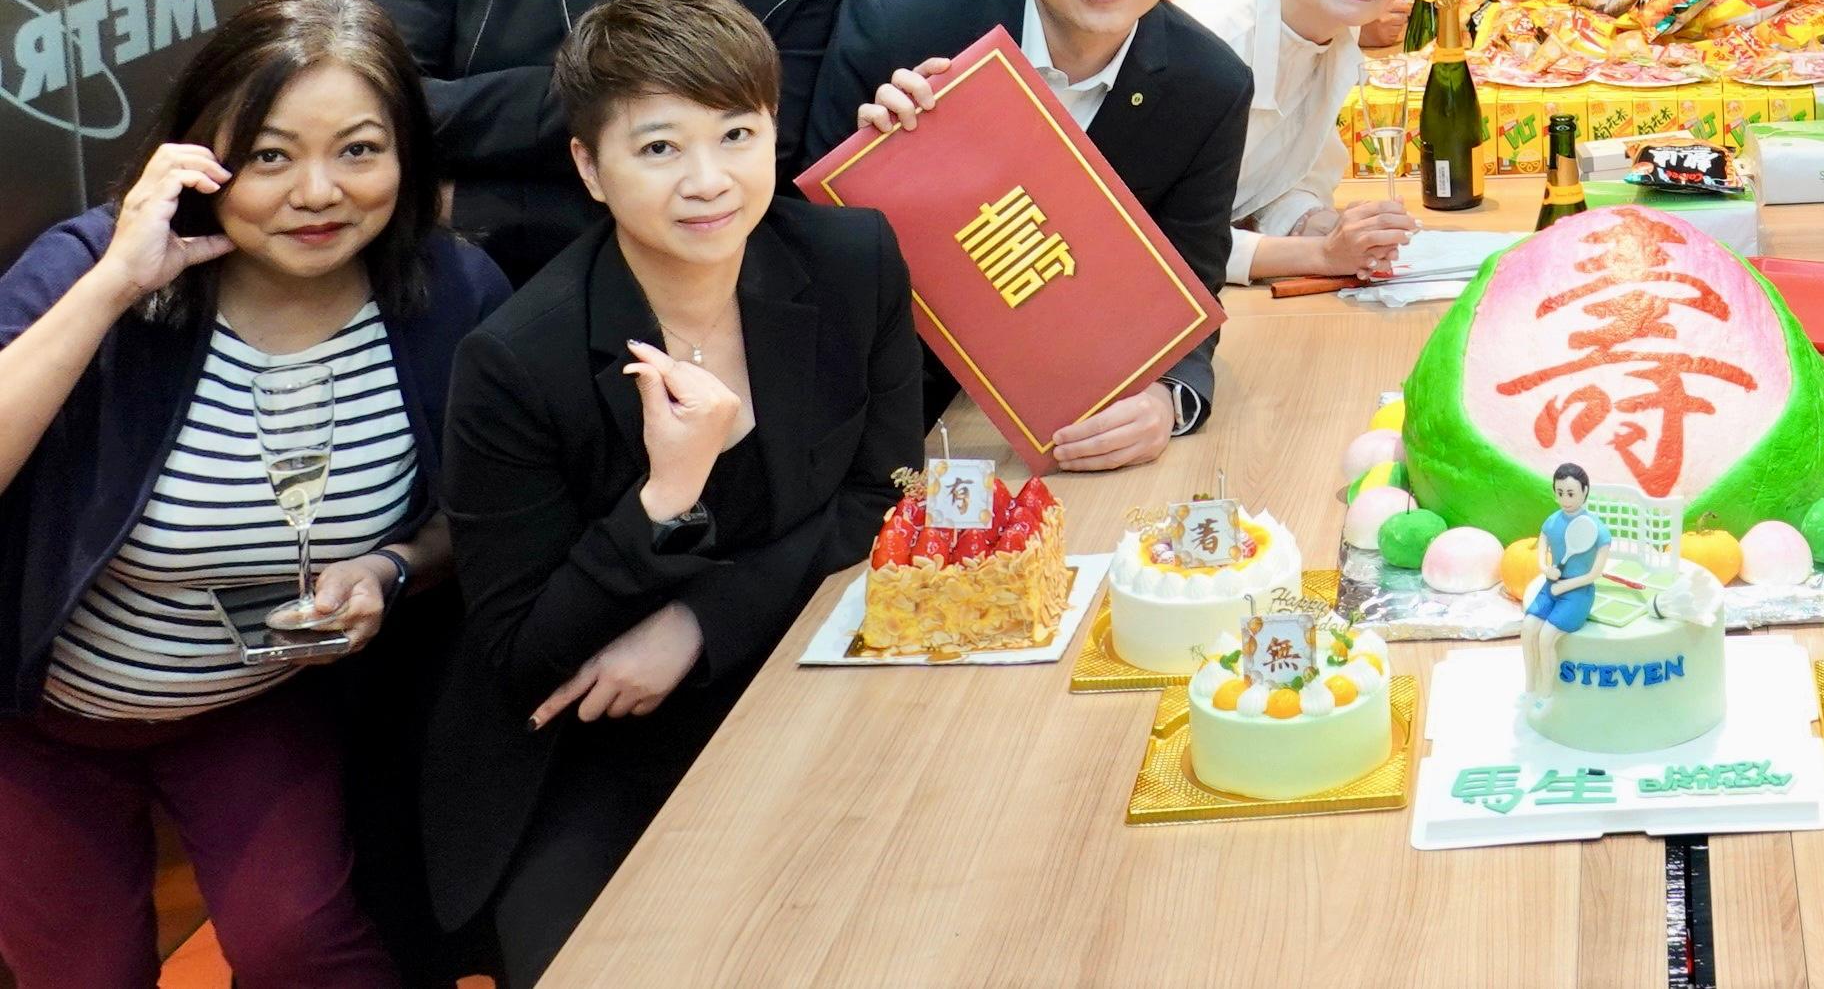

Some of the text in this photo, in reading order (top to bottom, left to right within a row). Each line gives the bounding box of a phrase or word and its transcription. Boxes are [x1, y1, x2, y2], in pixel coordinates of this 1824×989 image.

[953, 185, 1076, 309] 壽
[1496, 207, 1758, 498] 壽
[944, 477, 973, 515] 有
[1270, 586, 1331, 619] Happy
[1263, 636, 1301, 673] 無
[1560, 655, 1685, 687] STEVEN
[1450, 765, 1617, 813] 馬生
[1638, 772, 1793, 792] BIRTHDAY
[1664, 760, 1771, 781] HAPPY
